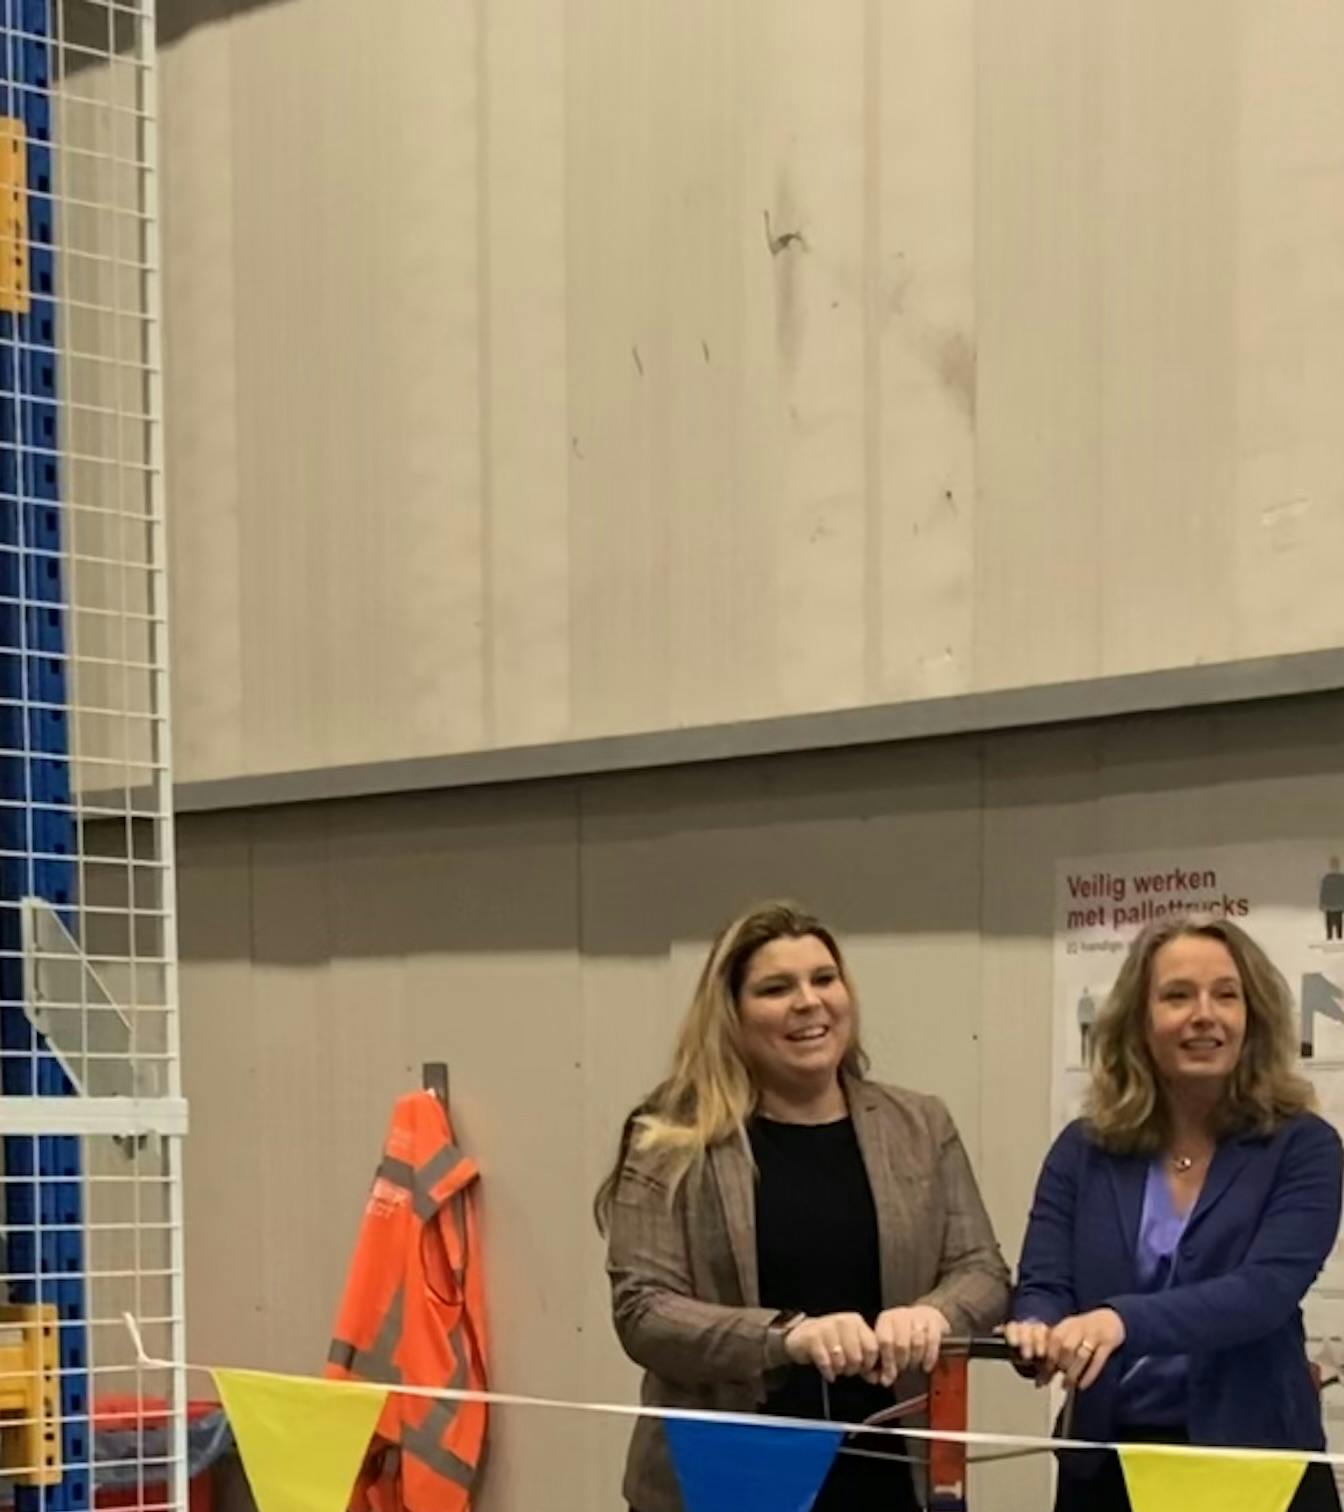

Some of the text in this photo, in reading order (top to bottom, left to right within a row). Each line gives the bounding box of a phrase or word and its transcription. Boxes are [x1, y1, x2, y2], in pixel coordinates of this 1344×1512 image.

[1066, 867, 1217, 901] Veilig werken
[1066, 906, 1106, 930] met
